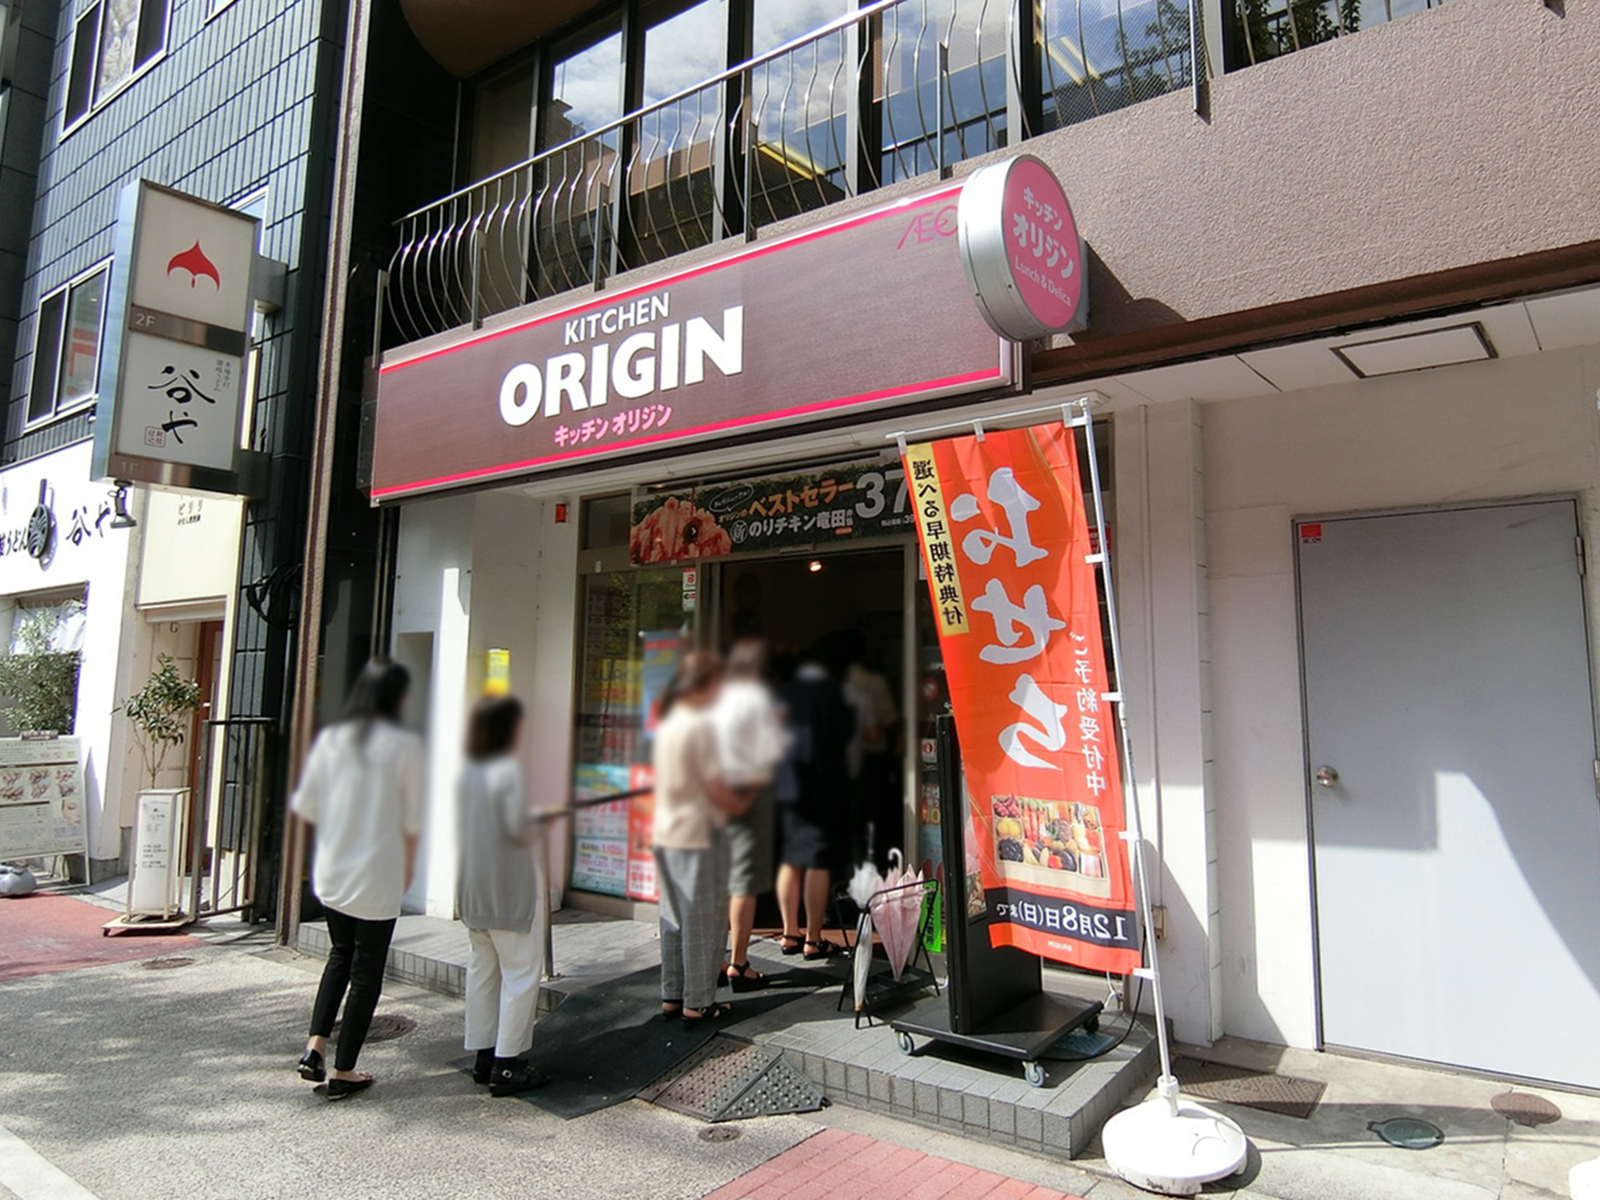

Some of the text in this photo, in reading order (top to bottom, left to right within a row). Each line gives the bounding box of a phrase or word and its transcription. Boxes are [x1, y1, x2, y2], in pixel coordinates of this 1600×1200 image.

[896, 205, 959, 250] AEO
[1023, 187, 1063, 231] キッチン
[1013, 212, 1074, 278] オリジン
[1015, 255, 1040, 284] Lunch
[135, 312, 156, 327] 2F
[564, 292, 670, 346] KITCHEN
[499, 305, 744, 427] ORIGIN
[147, 365, 217, 444] 谷や
[554, 403, 673, 448] キッチン オリジン
[120, 461, 139, 474] 1F
[748, 480, 854, 516] ベストセラー
[748, 510, 847, 537] のりチキン竜田
